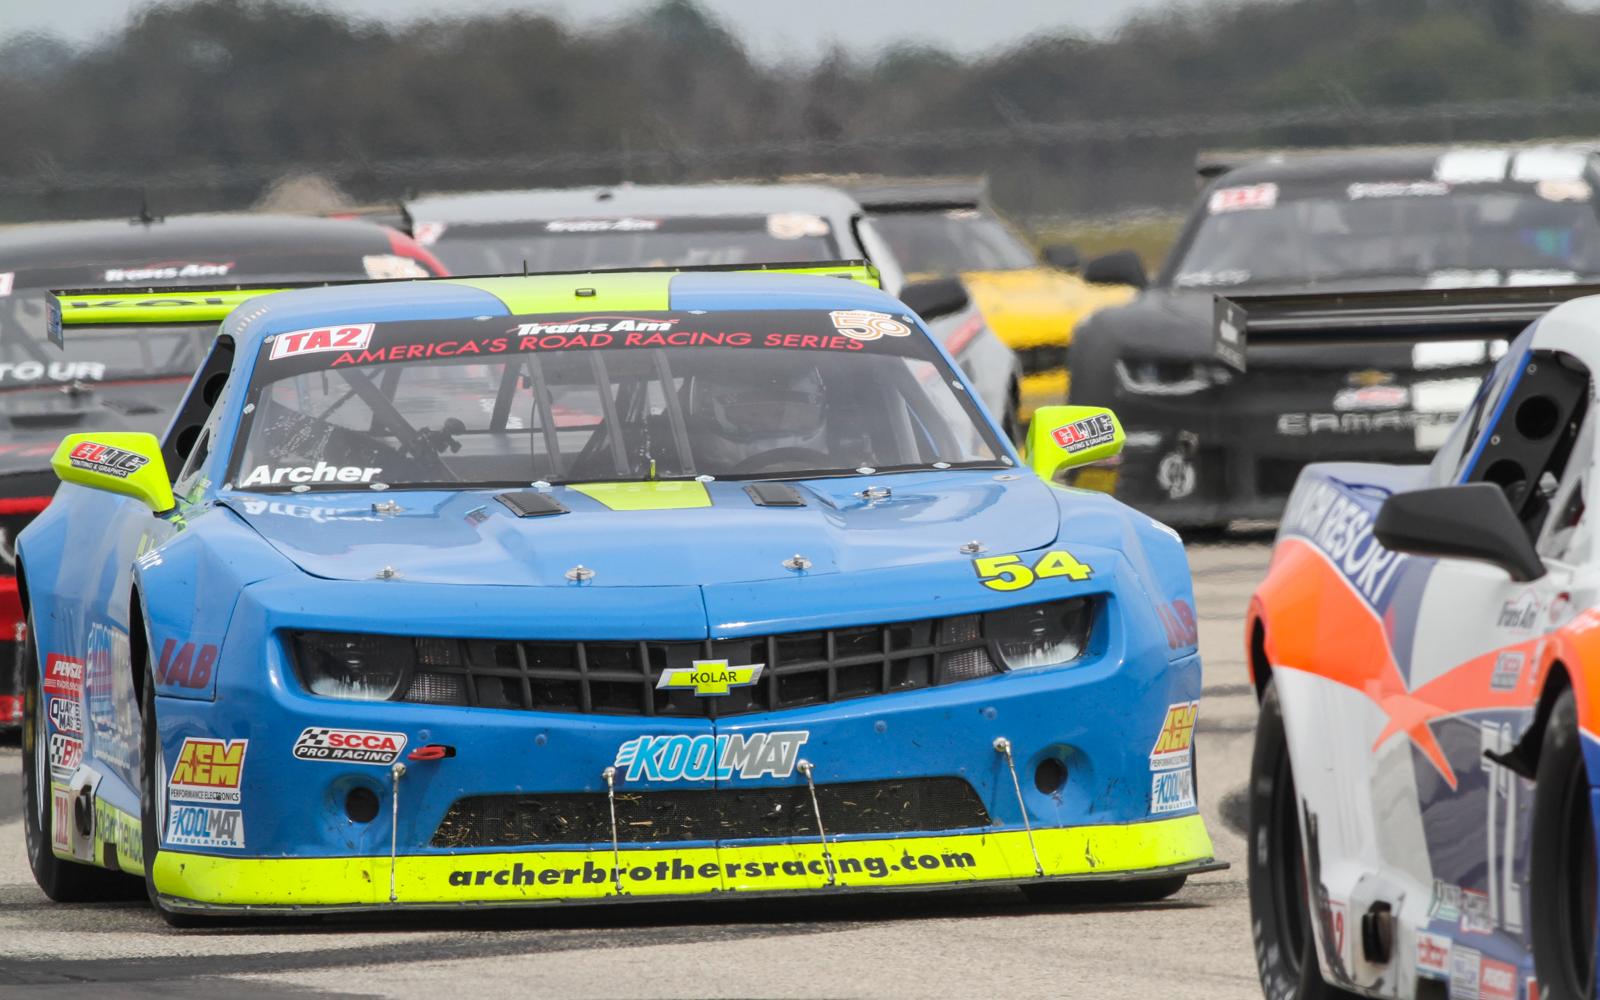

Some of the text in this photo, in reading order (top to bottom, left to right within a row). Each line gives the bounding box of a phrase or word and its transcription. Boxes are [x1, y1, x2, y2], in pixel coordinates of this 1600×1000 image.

[284, 327, 363, 353] TA2
[517, 320, 673, 336] Trans Am
[331, 332, 864, 367] AMERICA'S ROAD RACING SERIES
[1052, 413, 1114, 447] ELITE
[70, 442, 149, 473] ELITE
[242, 461, 382, 488] Archer
[972, 549, 1095, 592] 54
[690, 671, 738, 684] KOLAR
[328, 733, 397, 751] SCCA
[1154, 704, 1198, 755] AEM
[172, 740, 247, 788] AEM
[297, 746, 394, 762] PRO RACING
[625, 731, 809, 782] KOOLMAT
[170, 790, 239, 802] PERFORMANCE ELECTRONICS
[172, 807, 241, 839] KOOLMAT
[171, 837, 238, 847] INSULATION
[448, 850, 977, 887] archerbrothersracing.com
